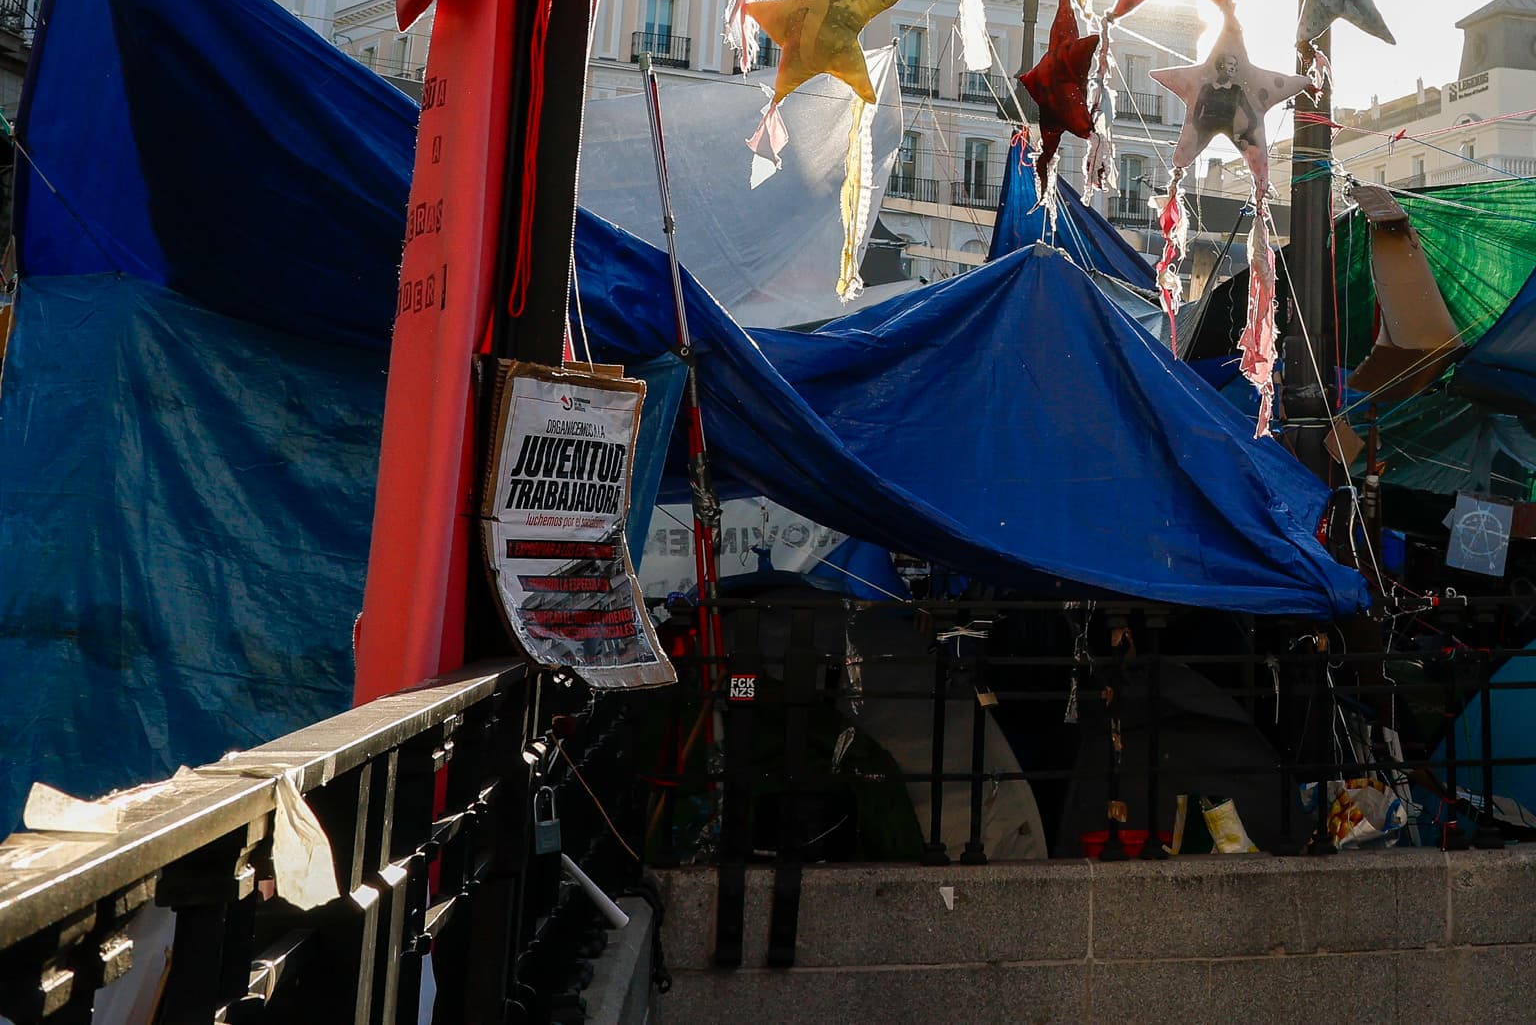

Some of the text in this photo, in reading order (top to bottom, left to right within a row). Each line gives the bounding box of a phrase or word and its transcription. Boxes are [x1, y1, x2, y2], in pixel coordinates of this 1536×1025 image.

[511, 435, 626, 484] JUVENTUD
[505, 478, 622, 515] TRABAJADORA
[525, 513, 563, 527] luchemos
[562, 517, 575, 529] por
[730, 677, 756, 688] FCK
[729, 687, 756, 698] NZS
